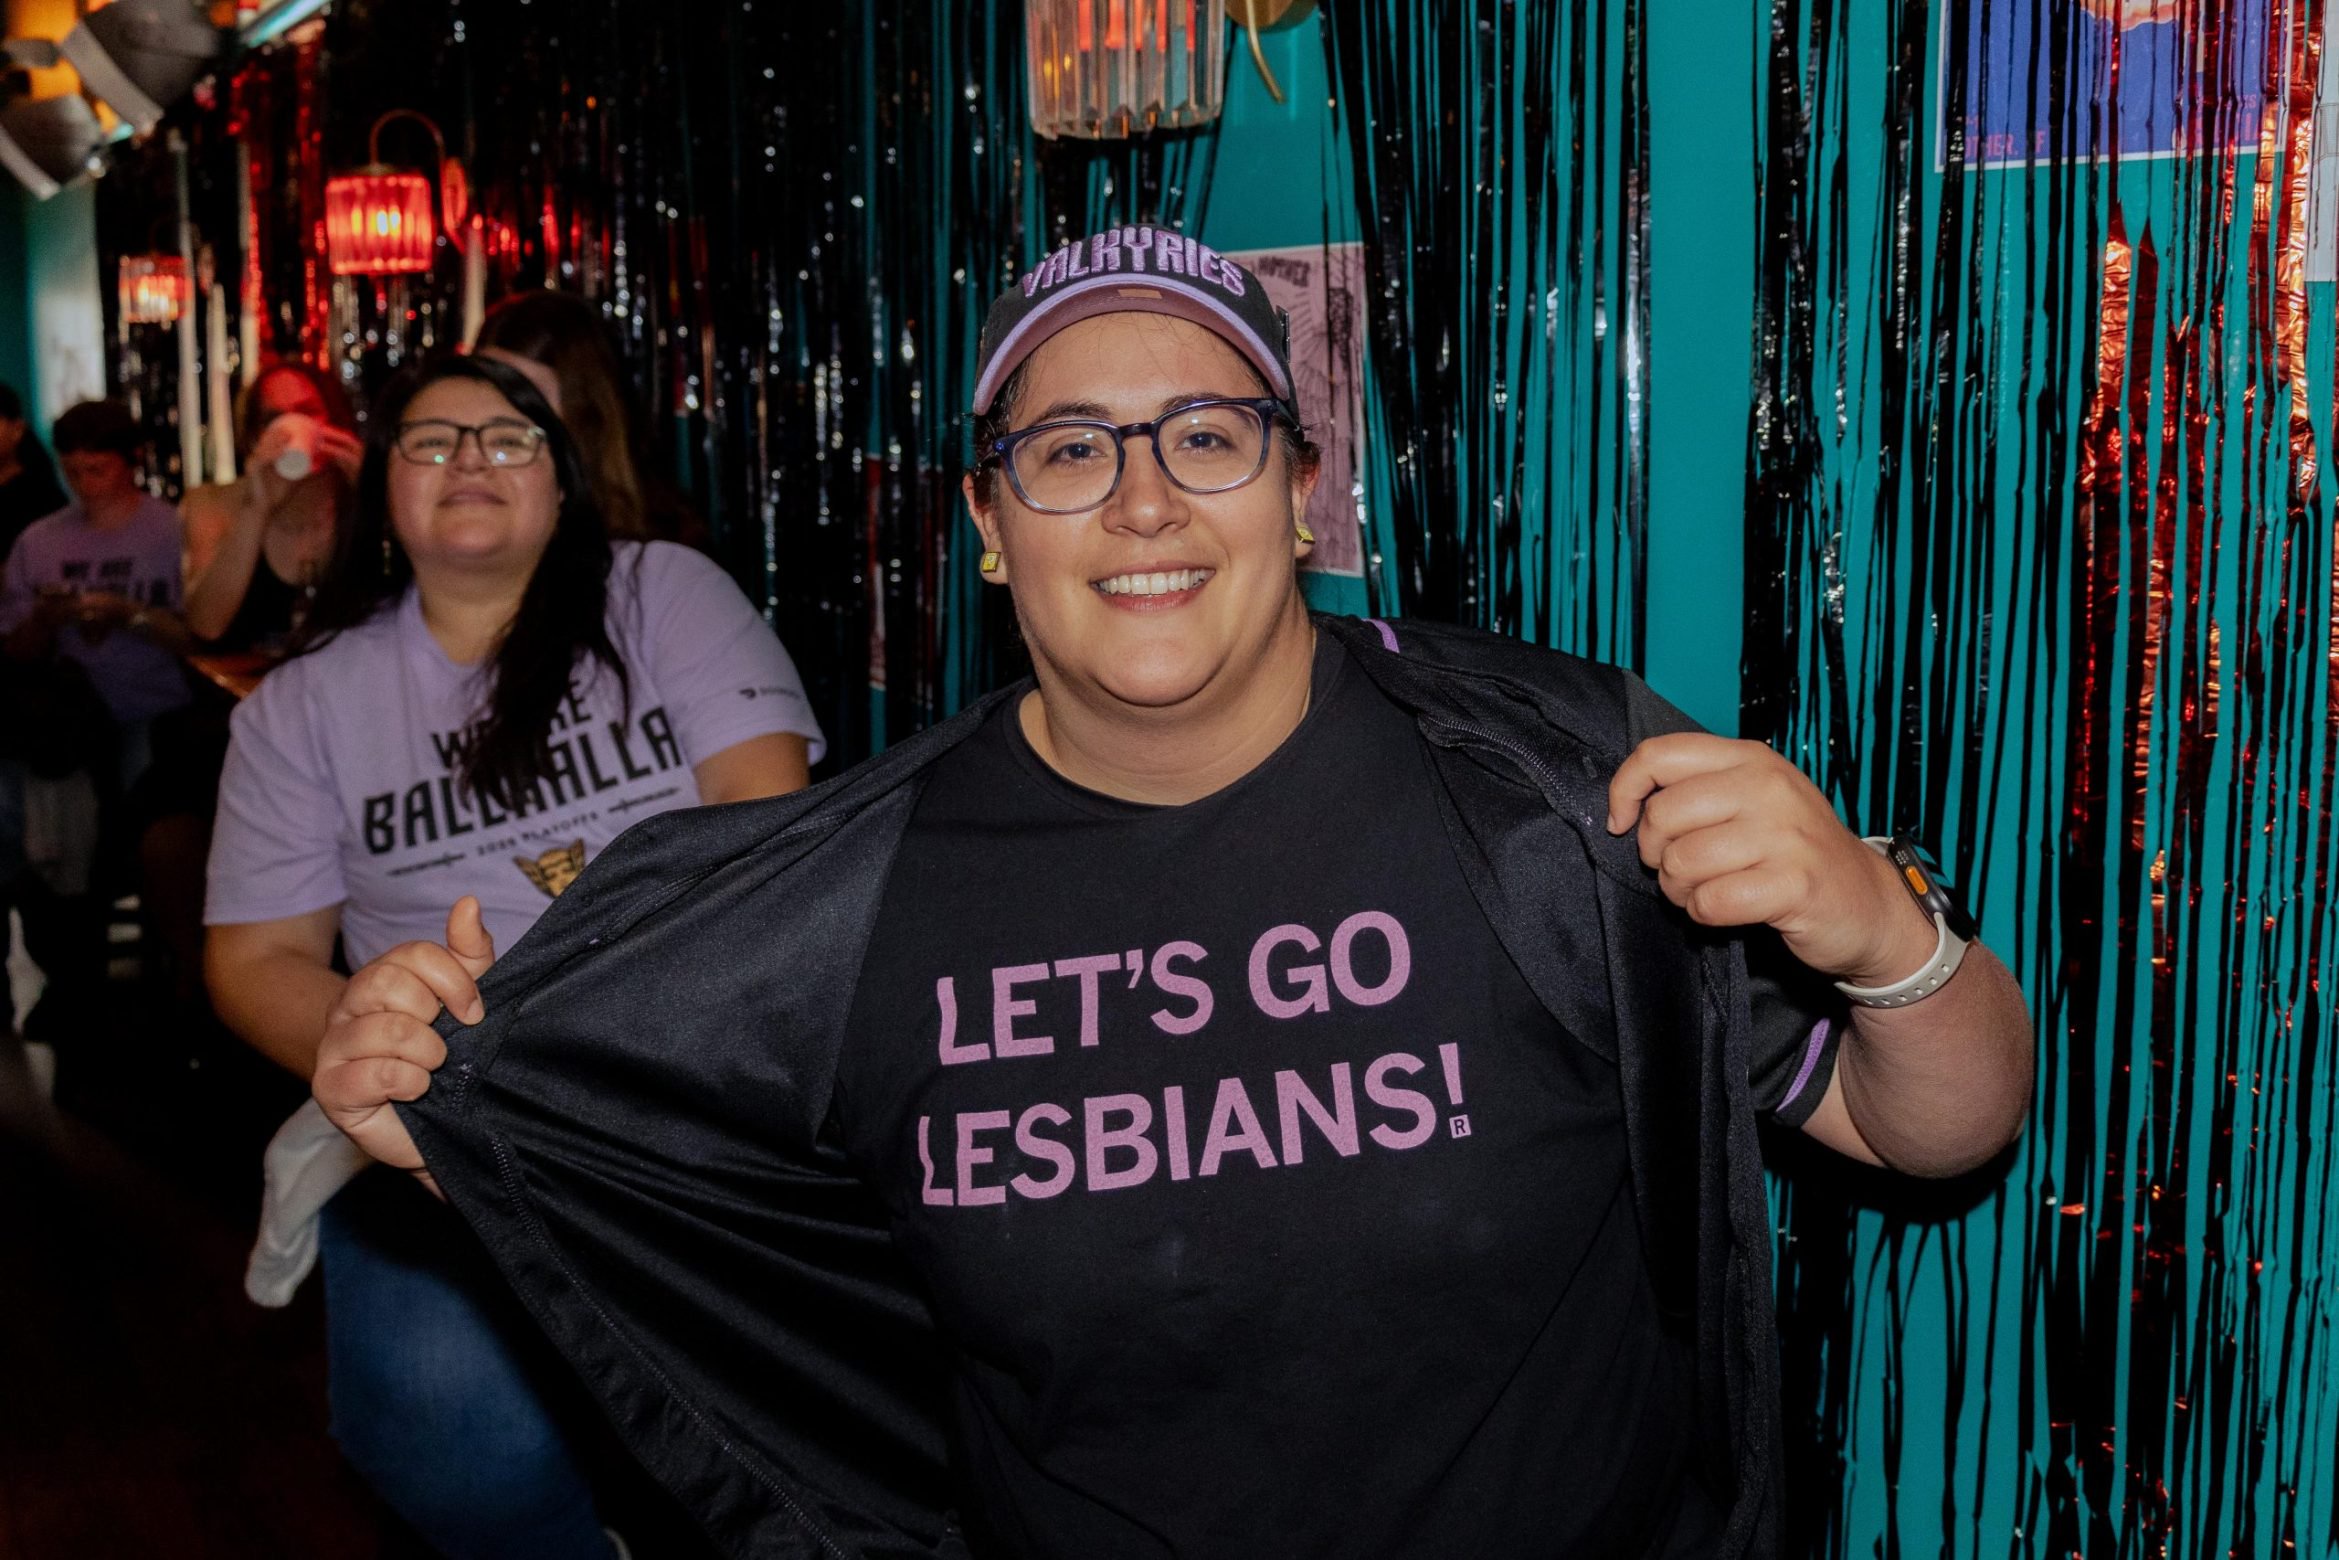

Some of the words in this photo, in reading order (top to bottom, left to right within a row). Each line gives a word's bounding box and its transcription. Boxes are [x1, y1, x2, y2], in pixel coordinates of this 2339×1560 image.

[1022, 226, 1246, 298] VALKYRIES
[936, 940, 1215, 1066] LET'S
[1248, 910, 1412, 1019] GO
[918, 1042, 1472, 1206] LESBIANS!
